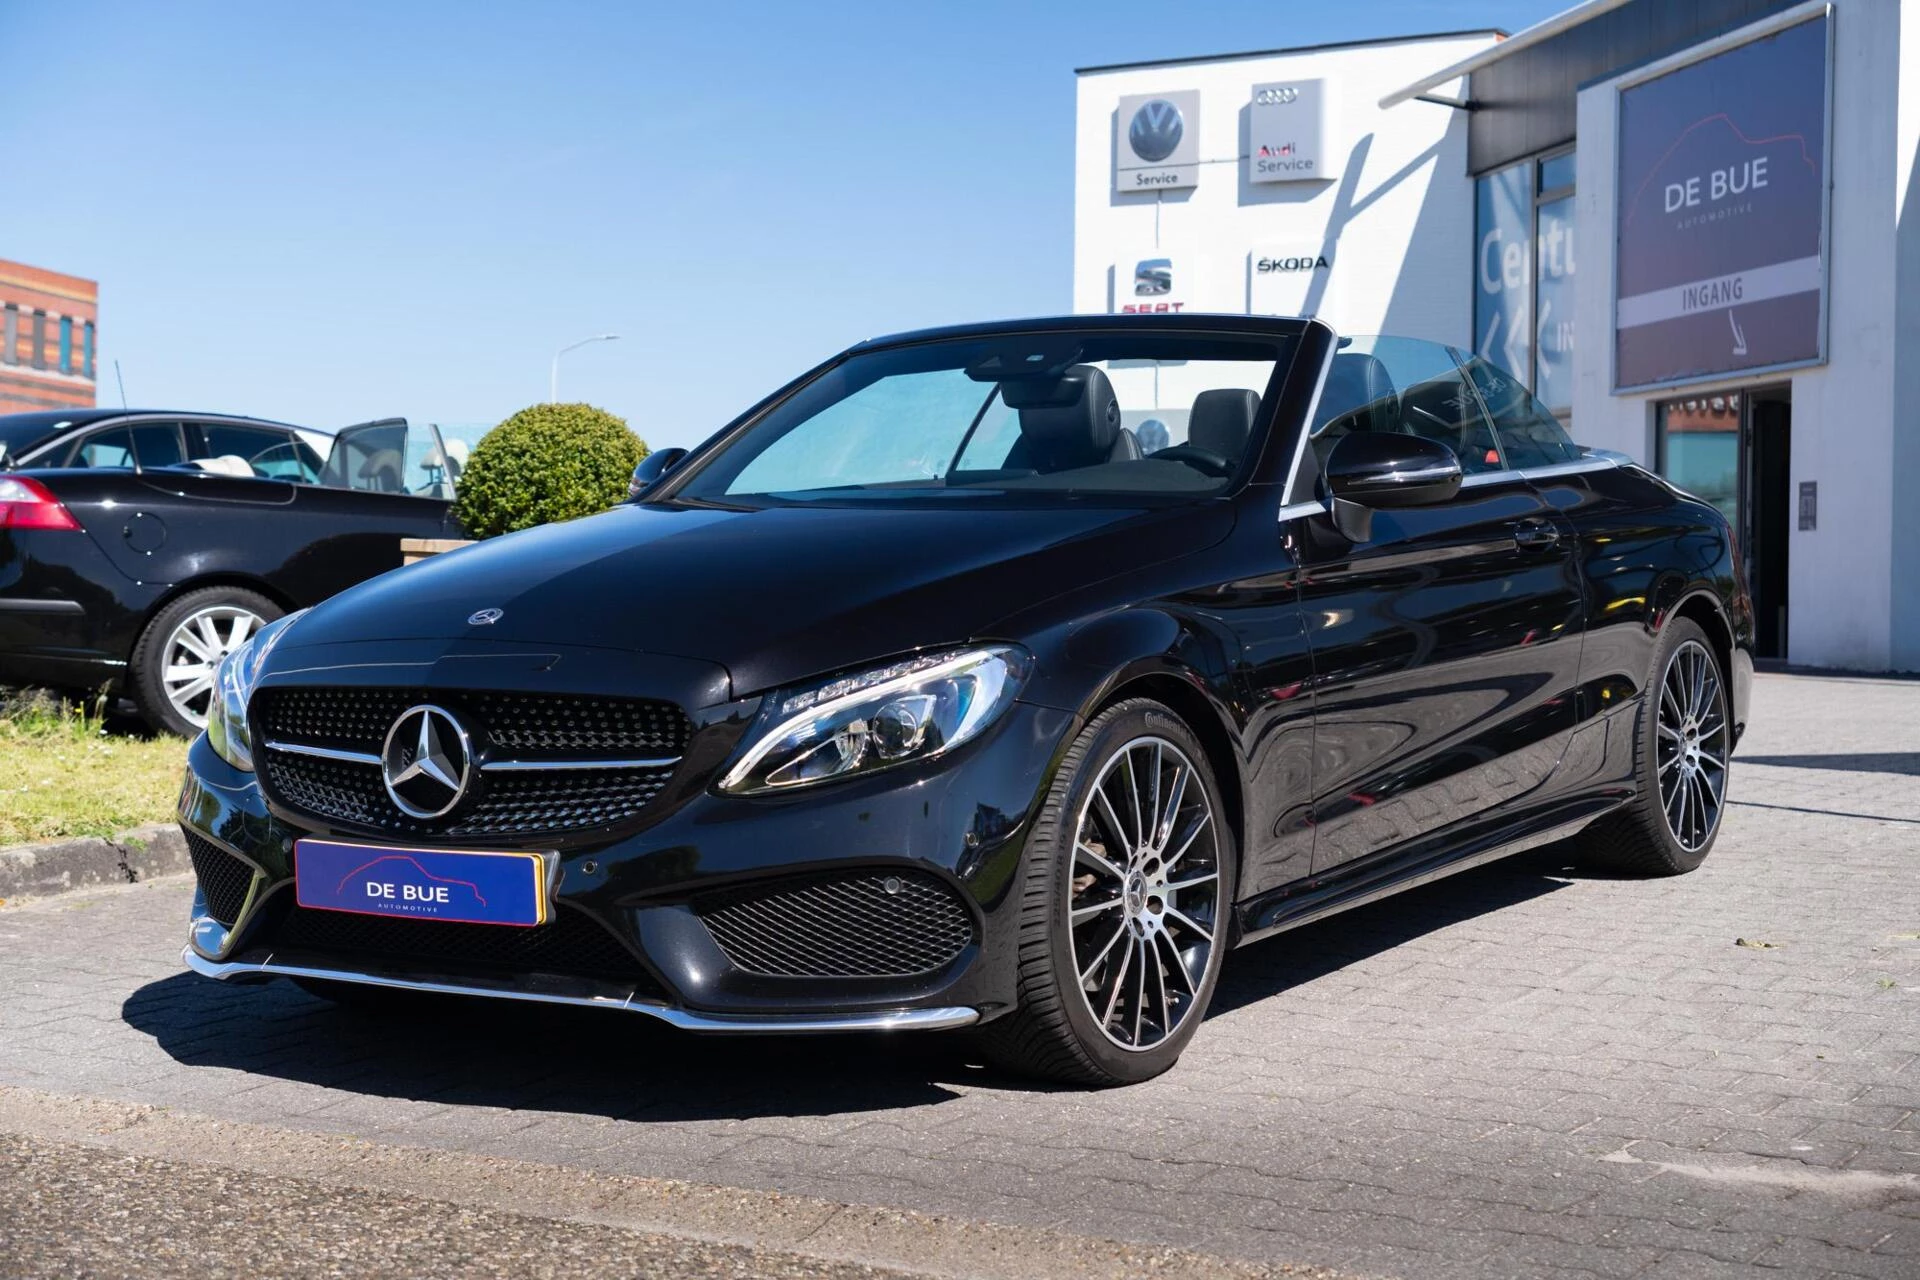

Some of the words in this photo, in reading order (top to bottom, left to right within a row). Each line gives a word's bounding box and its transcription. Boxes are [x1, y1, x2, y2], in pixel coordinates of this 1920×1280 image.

[1258, 142, 1295, 157] Audi
[1257, 158, 1314, 173] Service
[1136, 172, 1178, 186] Service
[1665, 176, 1701, 213] DE
[1710, 156, 1768, 200] BUE
[1677, 203, 1752, 230] AUTOMOTIVE
[1683, 277, 1743, 311] INGANG
[1123, 302, 1184, 313] SEAT
[366, 881, 396, 899] DE
[403, 884, 450, 903] BUE
[378, 903, 438, 913] AUTOMOTIVE
